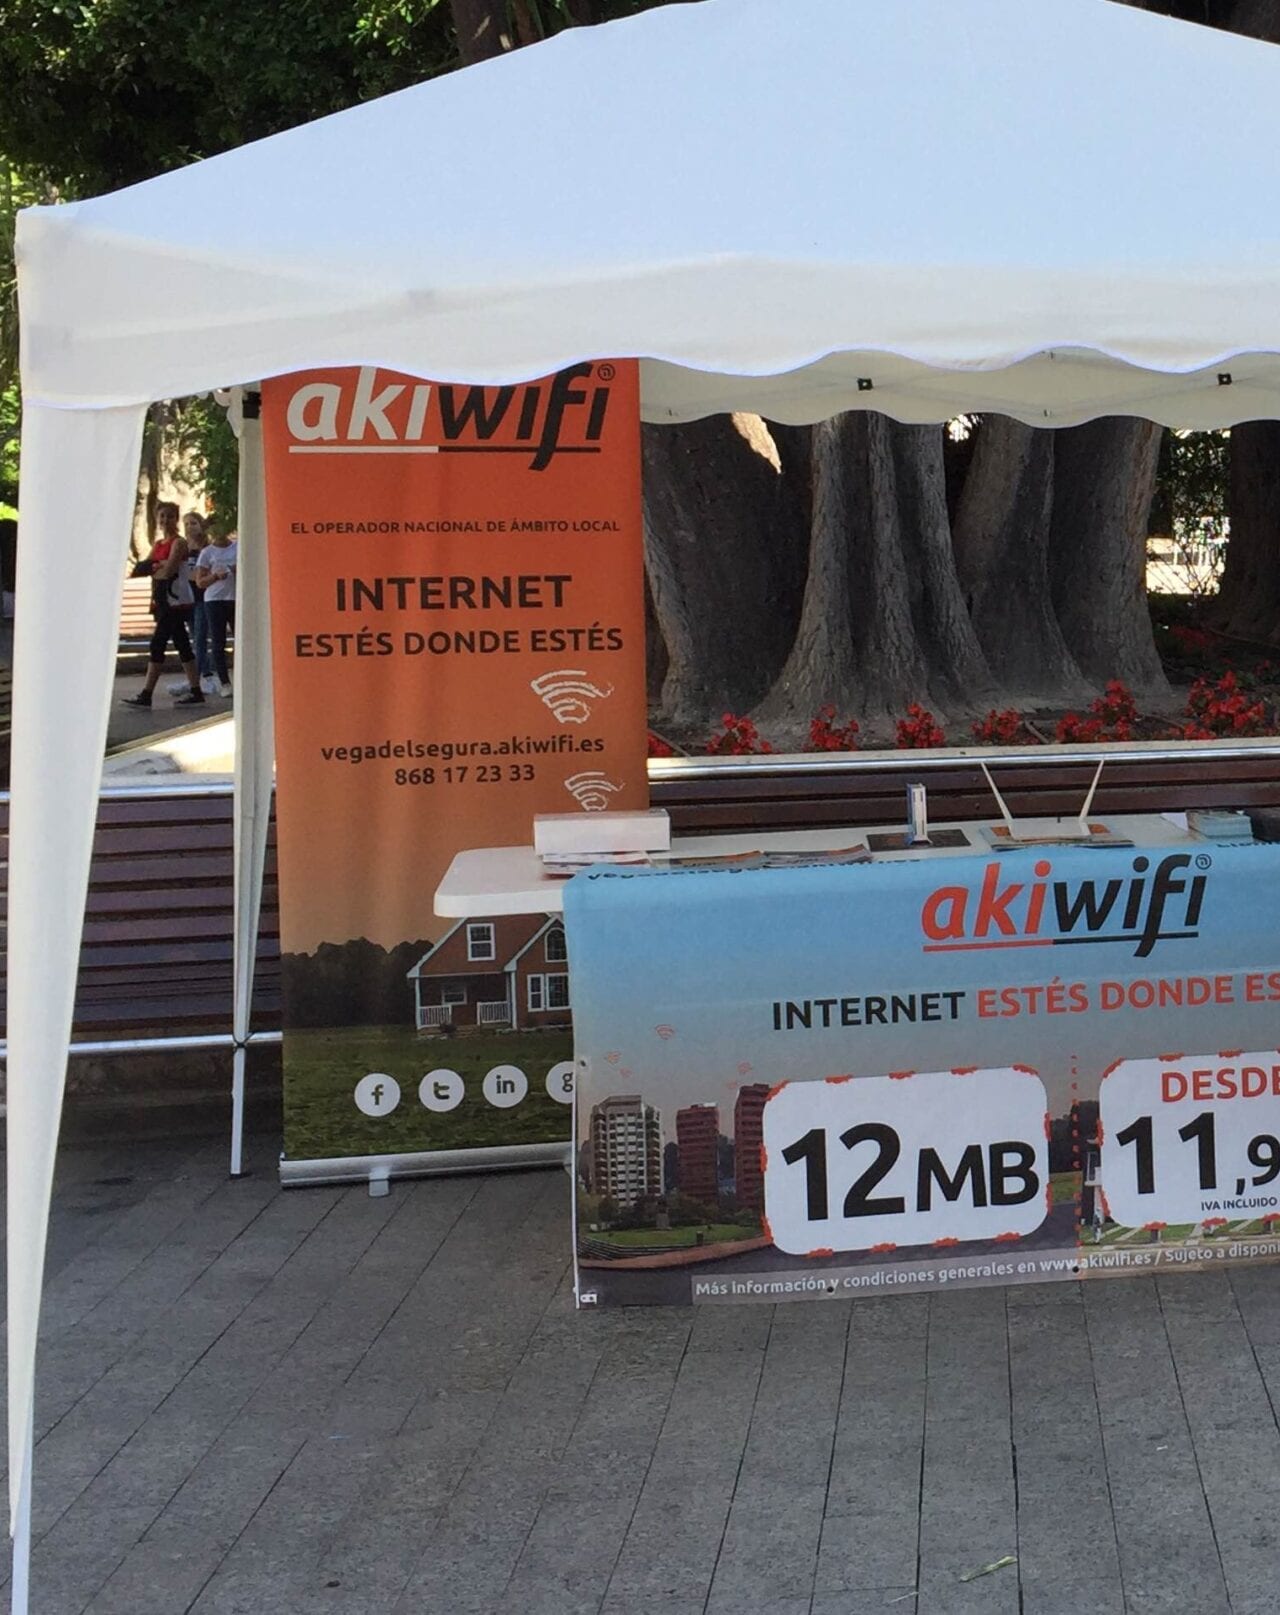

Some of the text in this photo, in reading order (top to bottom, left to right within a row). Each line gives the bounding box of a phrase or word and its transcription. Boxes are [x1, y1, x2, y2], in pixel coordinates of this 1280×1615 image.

[287, 363, 609, 471] akiwifi
[291, 516, 621, 534] EL OPERADOR NACIONAL DE ÁMBITO LOCAL
[336, 575, 572, 611] INTERNET
[295, 622, 624, 658] ESTÉS DONDE ESTÉS
[321, 734, 605, 764] vegadelsegura.akiwifi.es
[395, 764, 535, 786] 868 17 23 33
[921, 854, 1208, 958] akiwifi
[772, 991, 966, 1030] INTERNET
[977, 976, 1089, 1019] ESTÉS
[1100, 975, 1234, 1011] DONDE
[1201, 1196, 1278, 1212] IVA INCLUIDO
[695, 1282, 728, 1296] Más
[732, 1276, 826, 1295] información
[830, 1278, 839, 1291] y
[843, 1270, 935, 1288] condiciones
[938, 1262, 1013, 1283] generales
[1017, 1262, 1036, 1273] en
[1165, 1247, 1213, 1264] Sujeto
[1216, 1249, 1225, 1258] a
